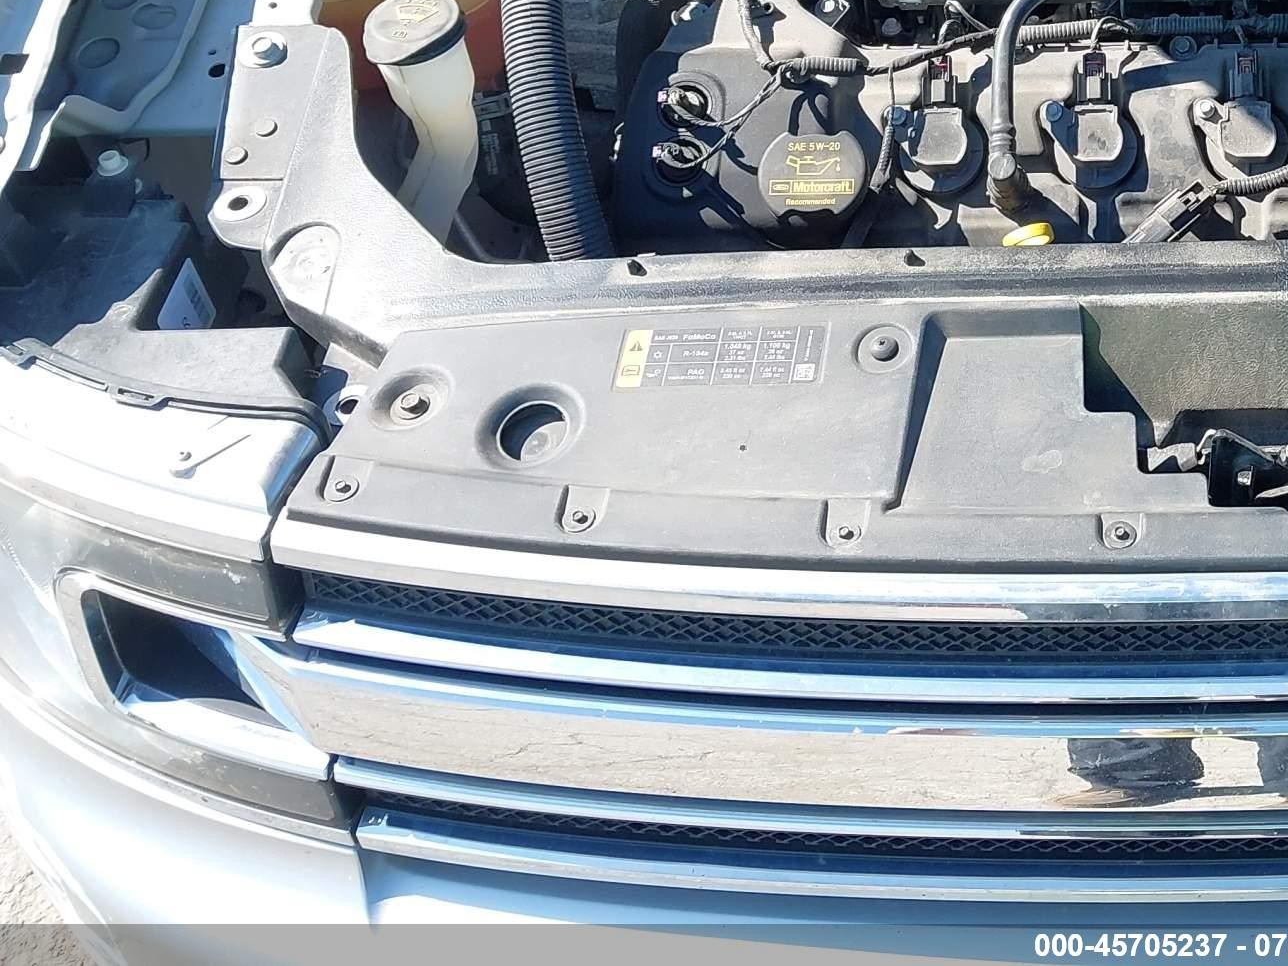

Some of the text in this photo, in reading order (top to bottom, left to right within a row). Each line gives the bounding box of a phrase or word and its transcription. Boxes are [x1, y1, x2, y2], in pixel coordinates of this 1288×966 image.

[788, 142, 840, 151] SAE 5W-20
[793, 181, 852, 193] Motorcraft
[683, 333, 716, 341] FoMoCo
